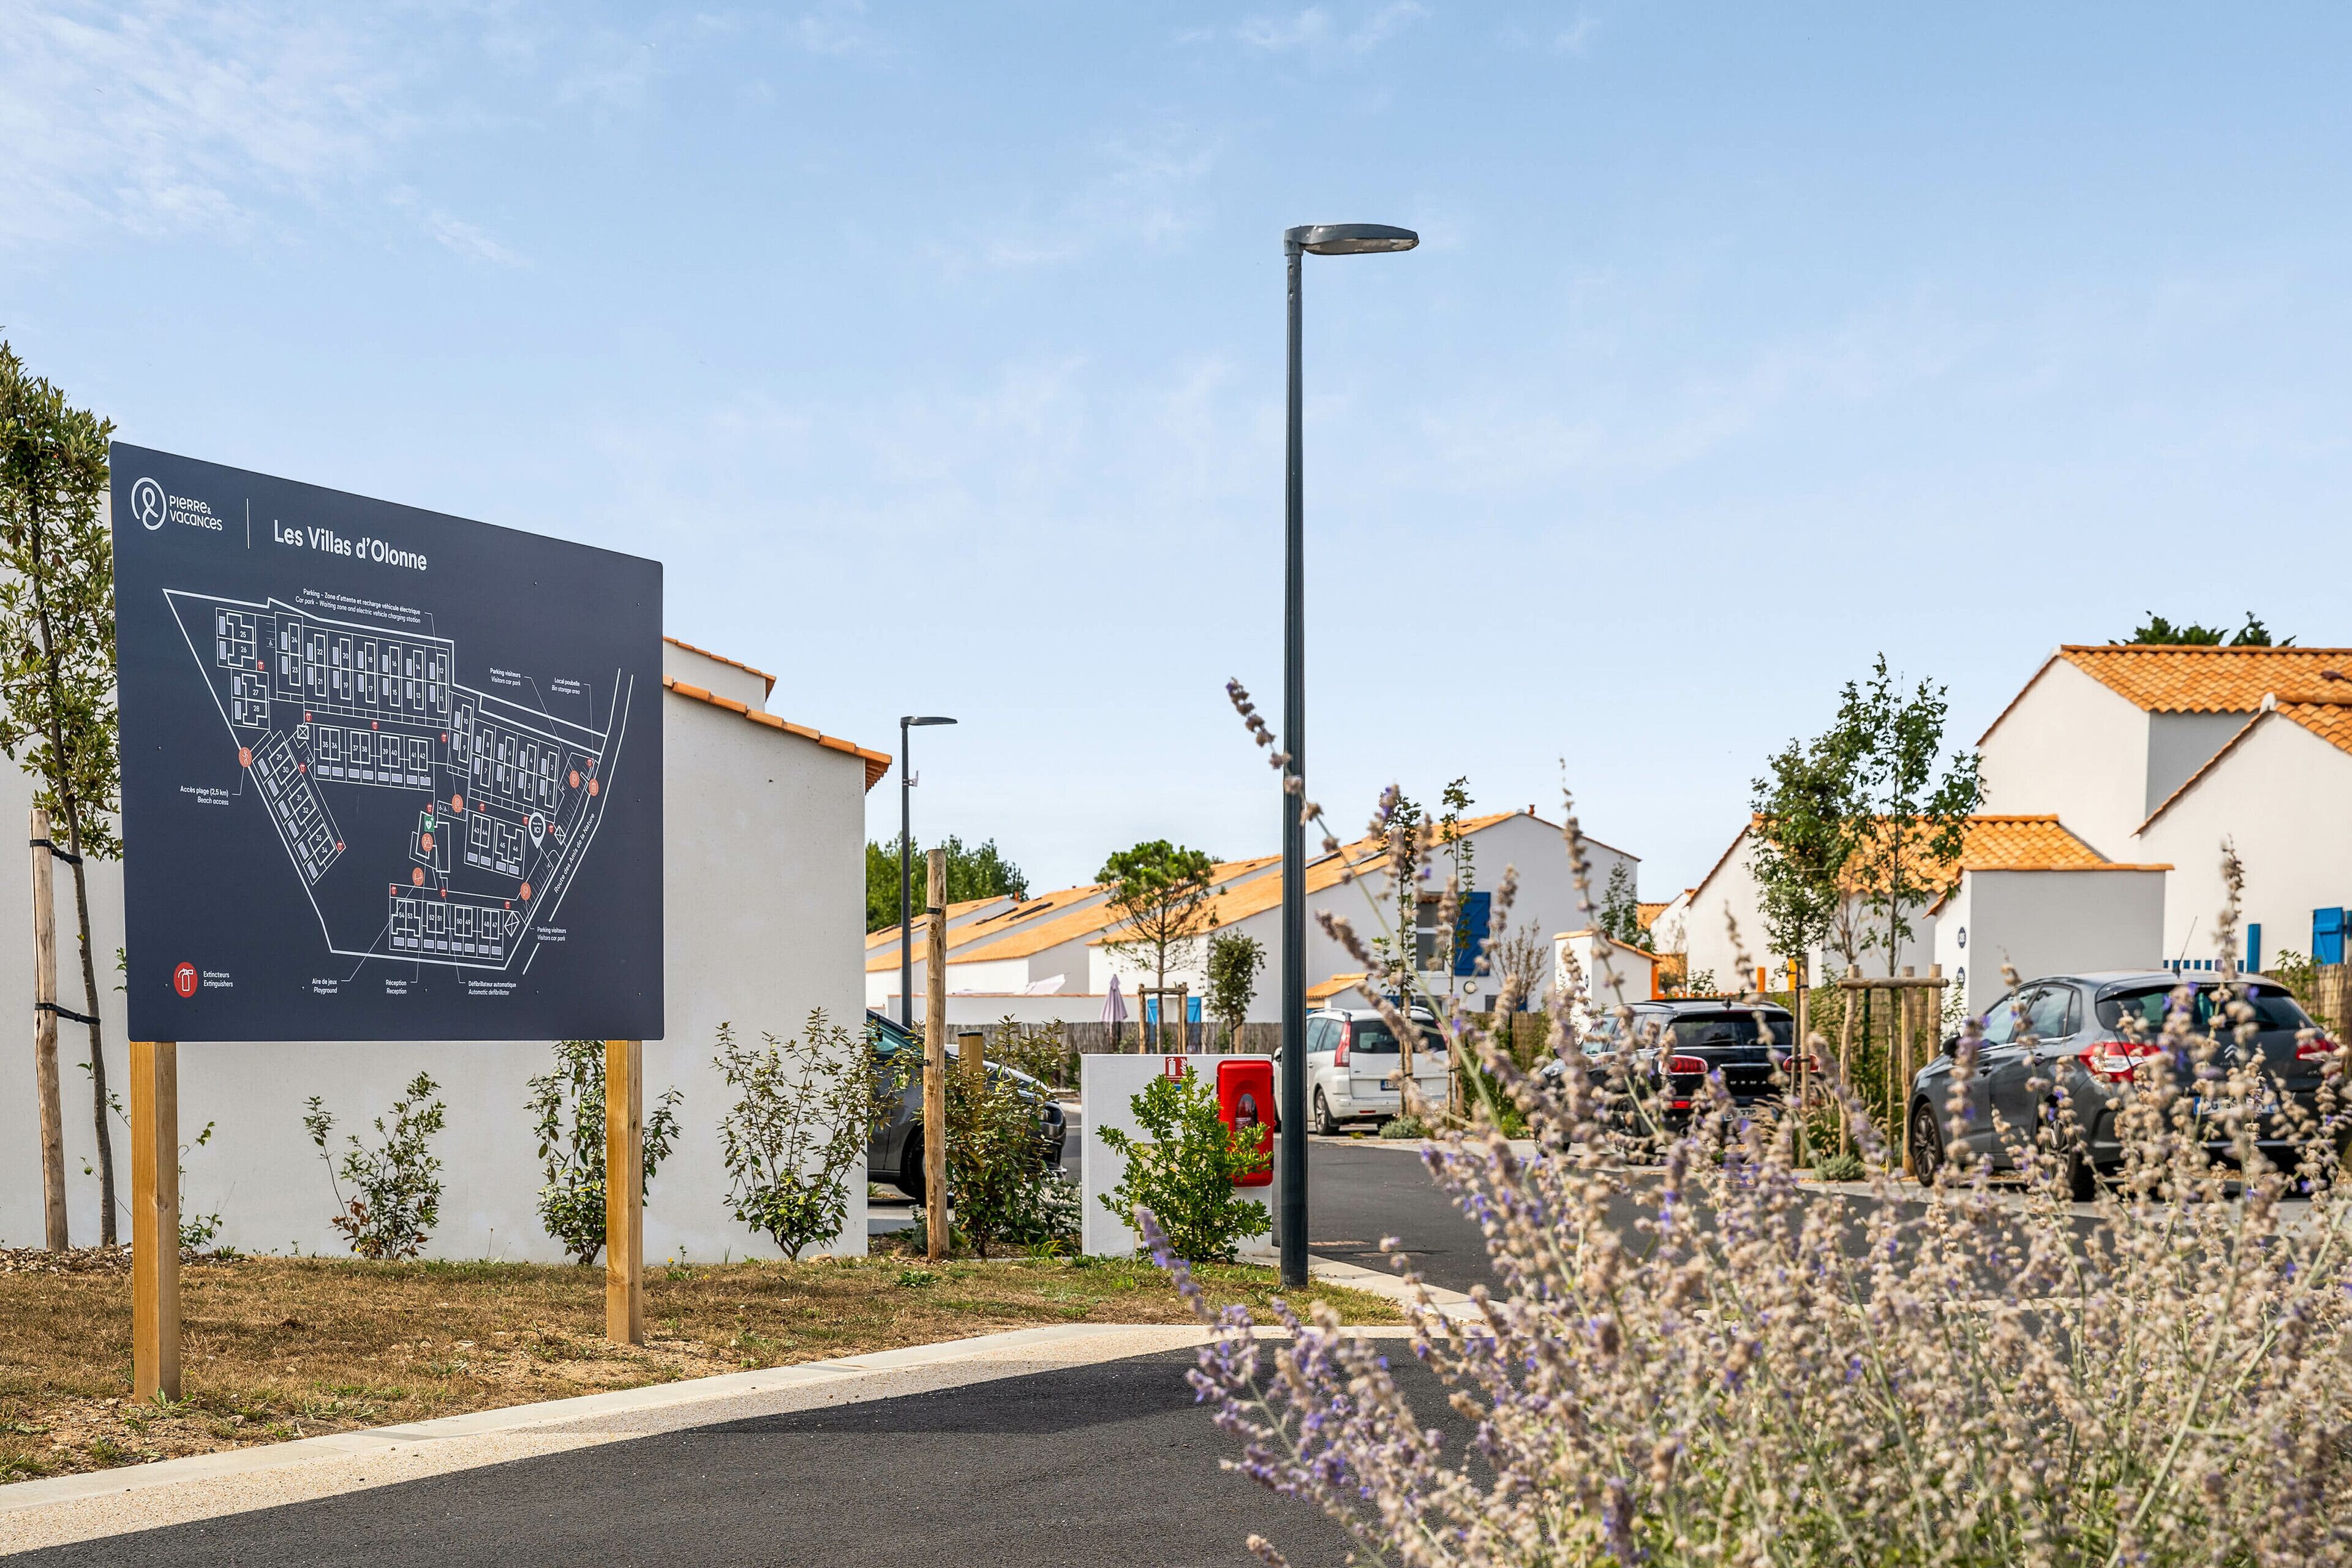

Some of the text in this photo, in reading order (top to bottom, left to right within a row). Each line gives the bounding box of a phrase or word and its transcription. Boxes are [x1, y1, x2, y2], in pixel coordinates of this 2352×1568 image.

[274, 519, 428, 571] Les Villas d'Olonne
[303, 588, 320, 599] Parking
[336, 594, 356, 604] d'attente
[362, 600, 382, 609] recharge
[399, 606, 421, 615] électrique
[319, 600, 336, 611] Waiting
[388, 612, 406, 622] charging
[490, 668, 505, 677] Parking
[196, 787, 209, 796] plage
[209, 788, 219, 796] (2,5
[219, 789, 228, 798] km)
[554, 874, 565, 894] Route
[568, 848, 578, 864] Amis
[576, 839, 582, 848] de
[582, 813, 595, 834] Nature
[203, 979, 233, 989] Extinguishers
[314, 986, 337, 995] Playground
